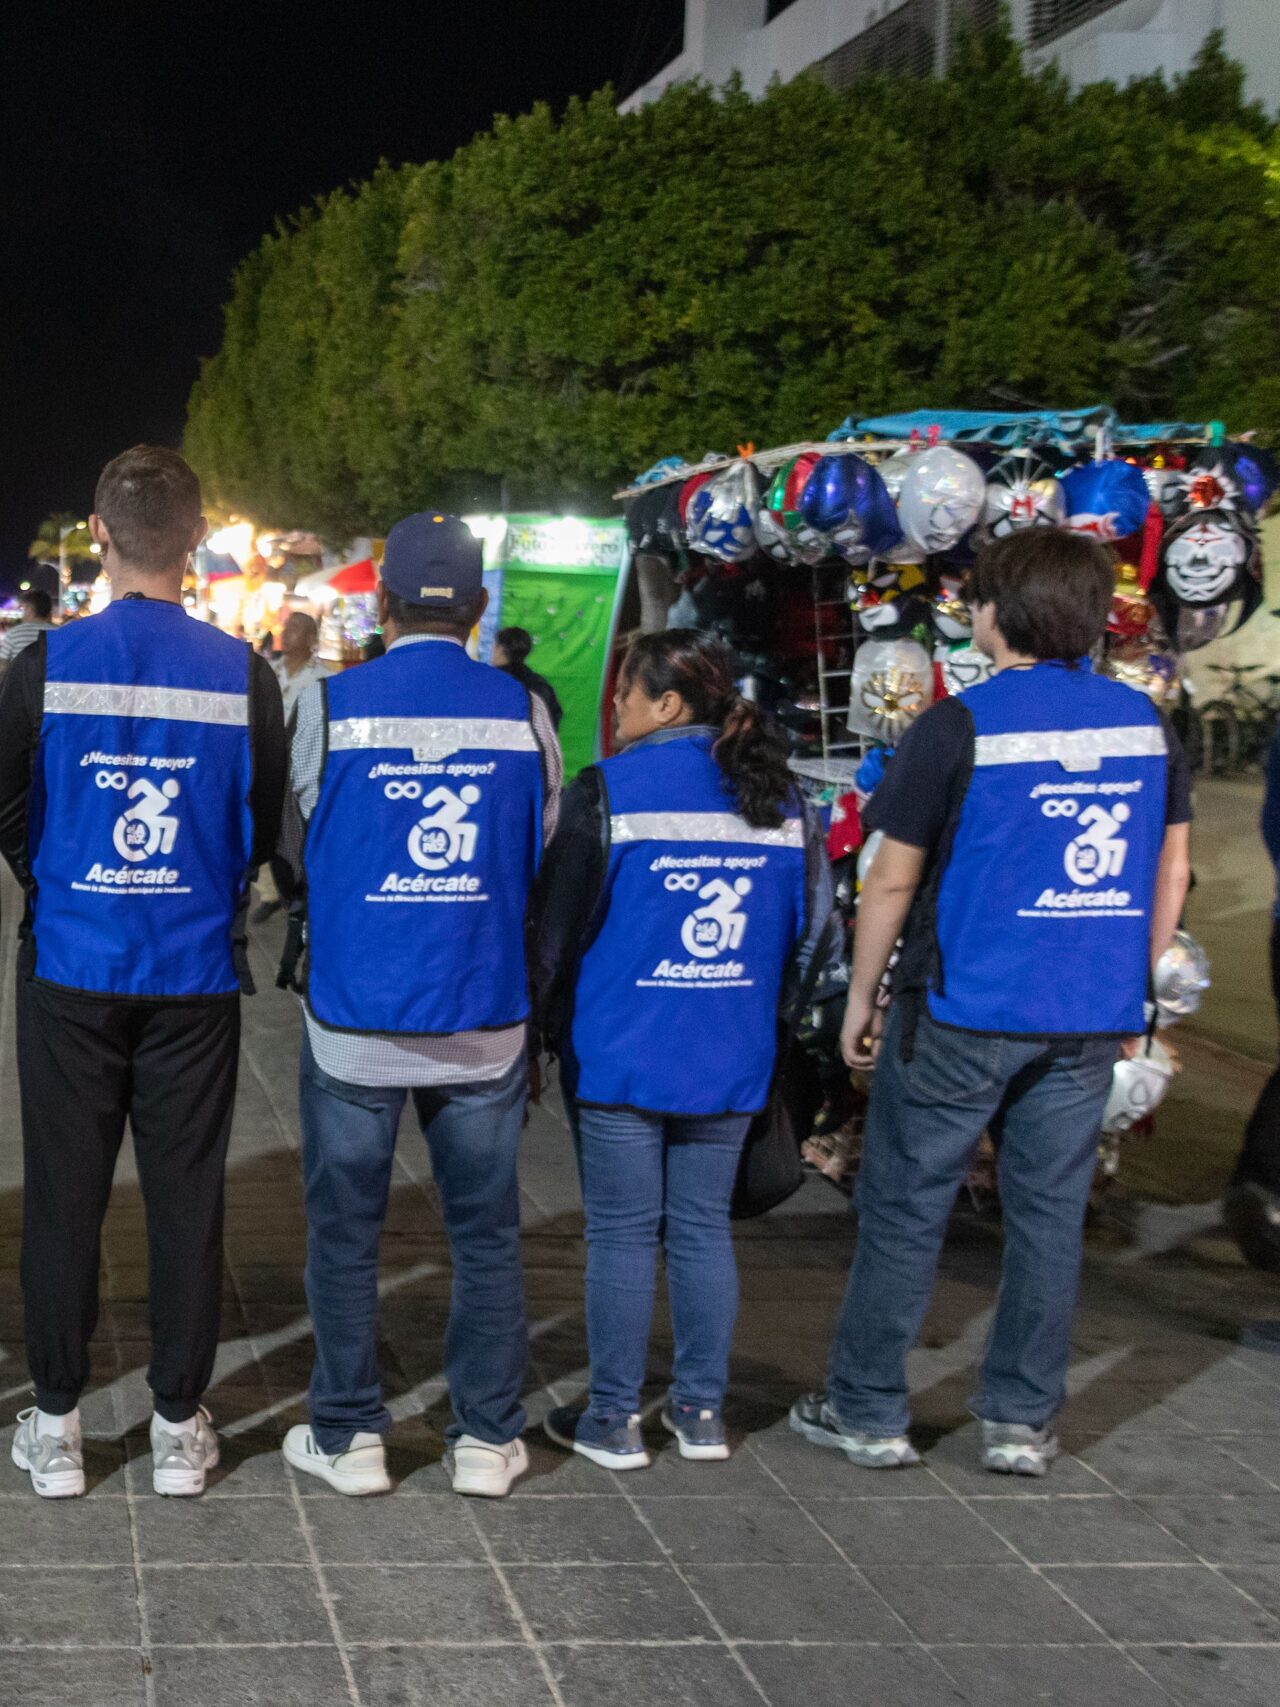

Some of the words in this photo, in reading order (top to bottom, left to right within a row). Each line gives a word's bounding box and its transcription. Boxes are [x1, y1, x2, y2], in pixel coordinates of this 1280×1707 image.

[80, 751, 147, 767] ¿Necesitas
[149, 756, 196, 771] apoyo?
[368, 763, 444, 779] ¿Necesitas
[446, 762, 496, 777] apoyo?
[85, 863, 179, 884] Acércate
[380, 872, 480, 893] Acércate
[652, 959, 744, 979] Acércate
